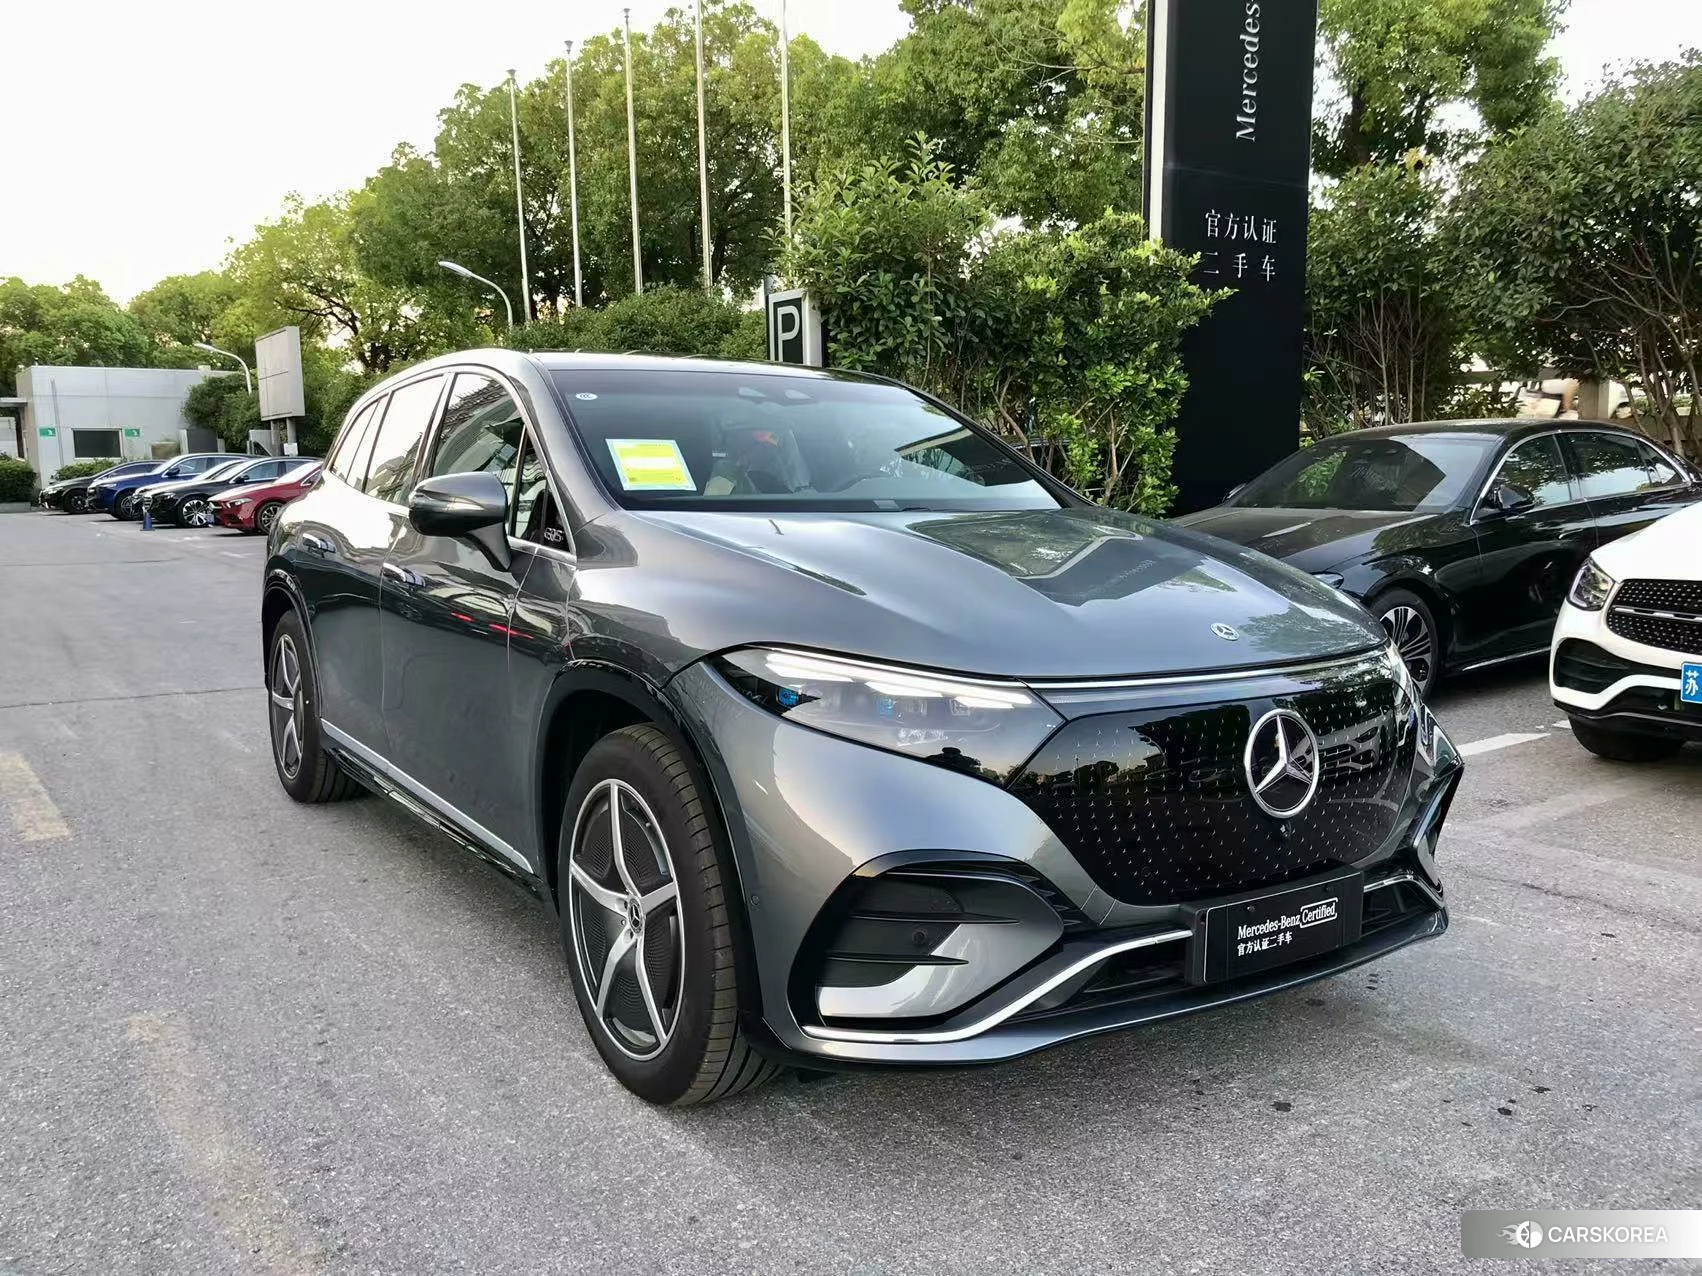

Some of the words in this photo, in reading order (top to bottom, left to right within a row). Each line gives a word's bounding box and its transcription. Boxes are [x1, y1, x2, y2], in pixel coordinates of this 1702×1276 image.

[1236, 0, 1261, 141] Mercedes
[1205, 209, 1277, 244] 官方认证
[1202, 251, 1276, 282] 二手车
[777, 305, 800, 362] P
[1685, 670, 1699, 697] 苏
[1237, 914, 1301, 940] Mercedes-Benz
[1302, 902, 1336, 923] Certified
[1237, 931, 1293, 956] 官方认证二手车
